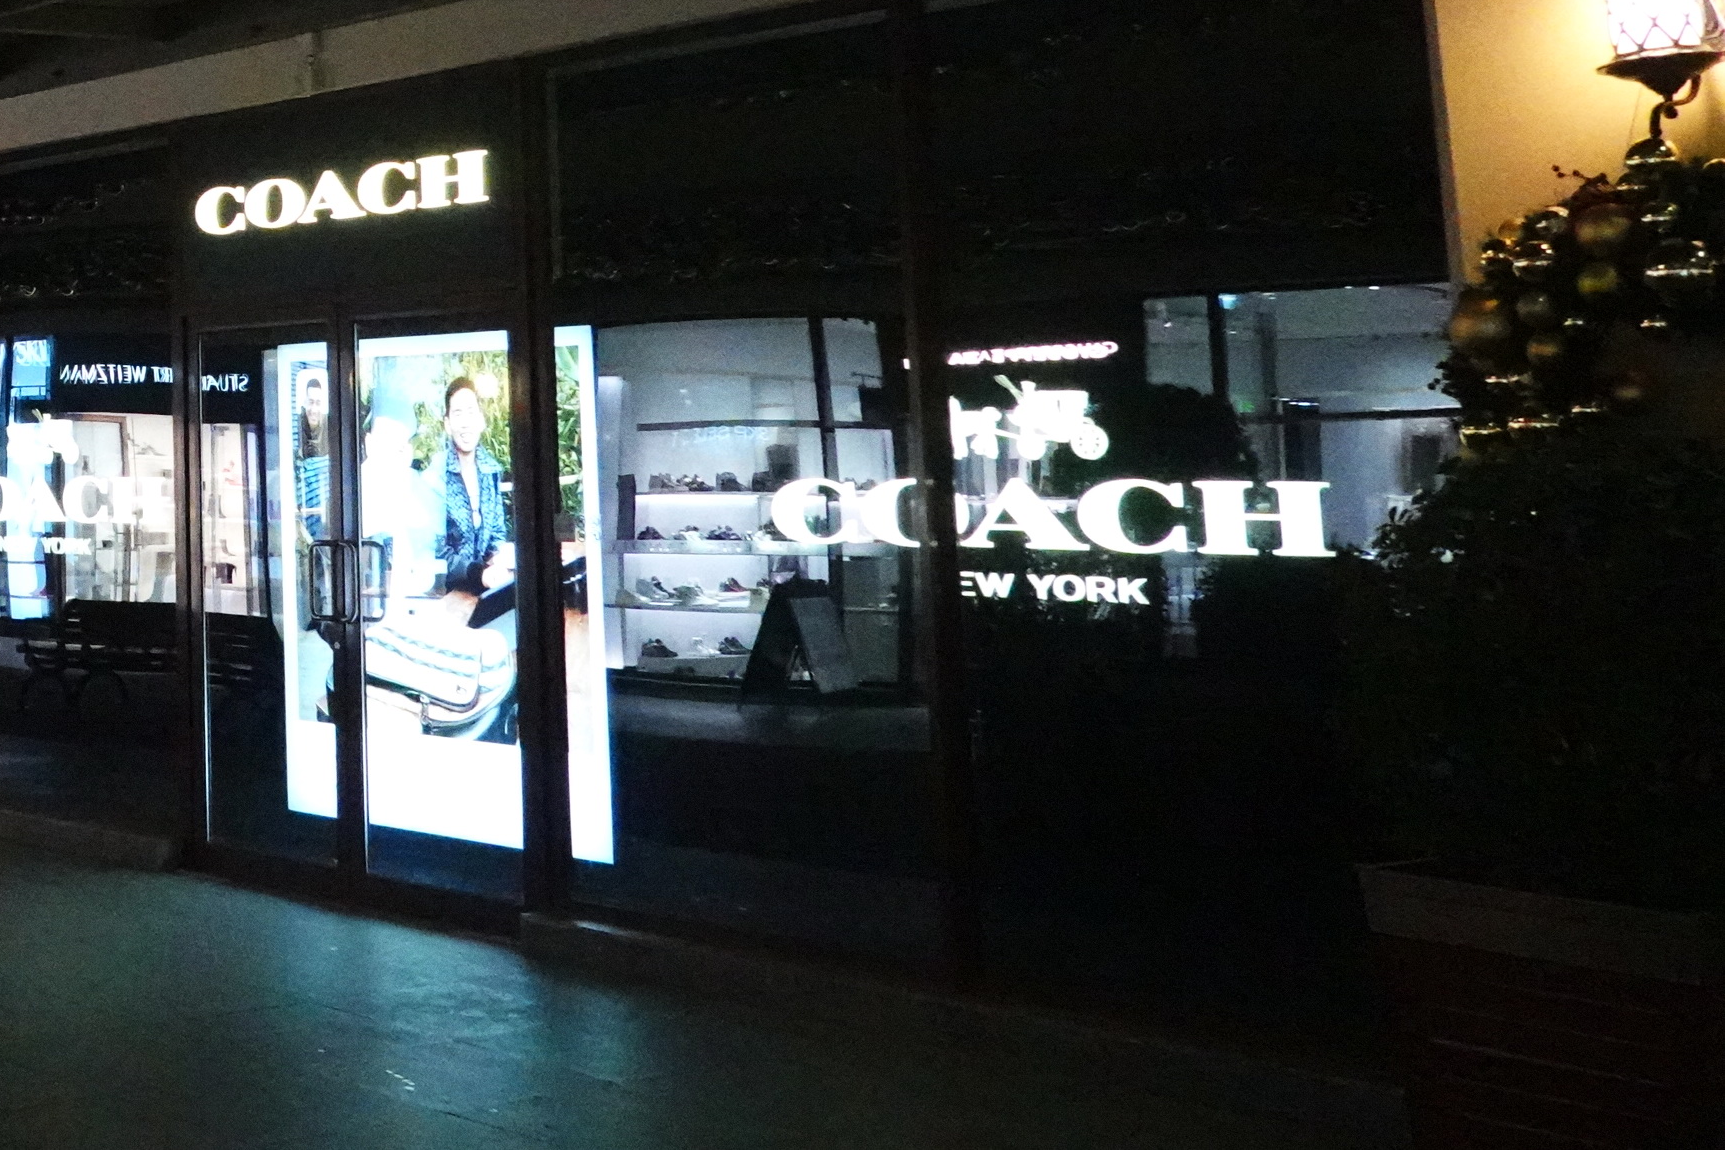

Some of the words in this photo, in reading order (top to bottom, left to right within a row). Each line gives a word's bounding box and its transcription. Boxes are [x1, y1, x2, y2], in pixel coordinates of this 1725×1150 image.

[194, 149, 489, 235] COACH
[40, 537, 92, 555] YORK
[770, 476, 1338, 558] COACH
[960, 570, 1015, 599] EW
[1026, 573, 1150, 605] YORK
